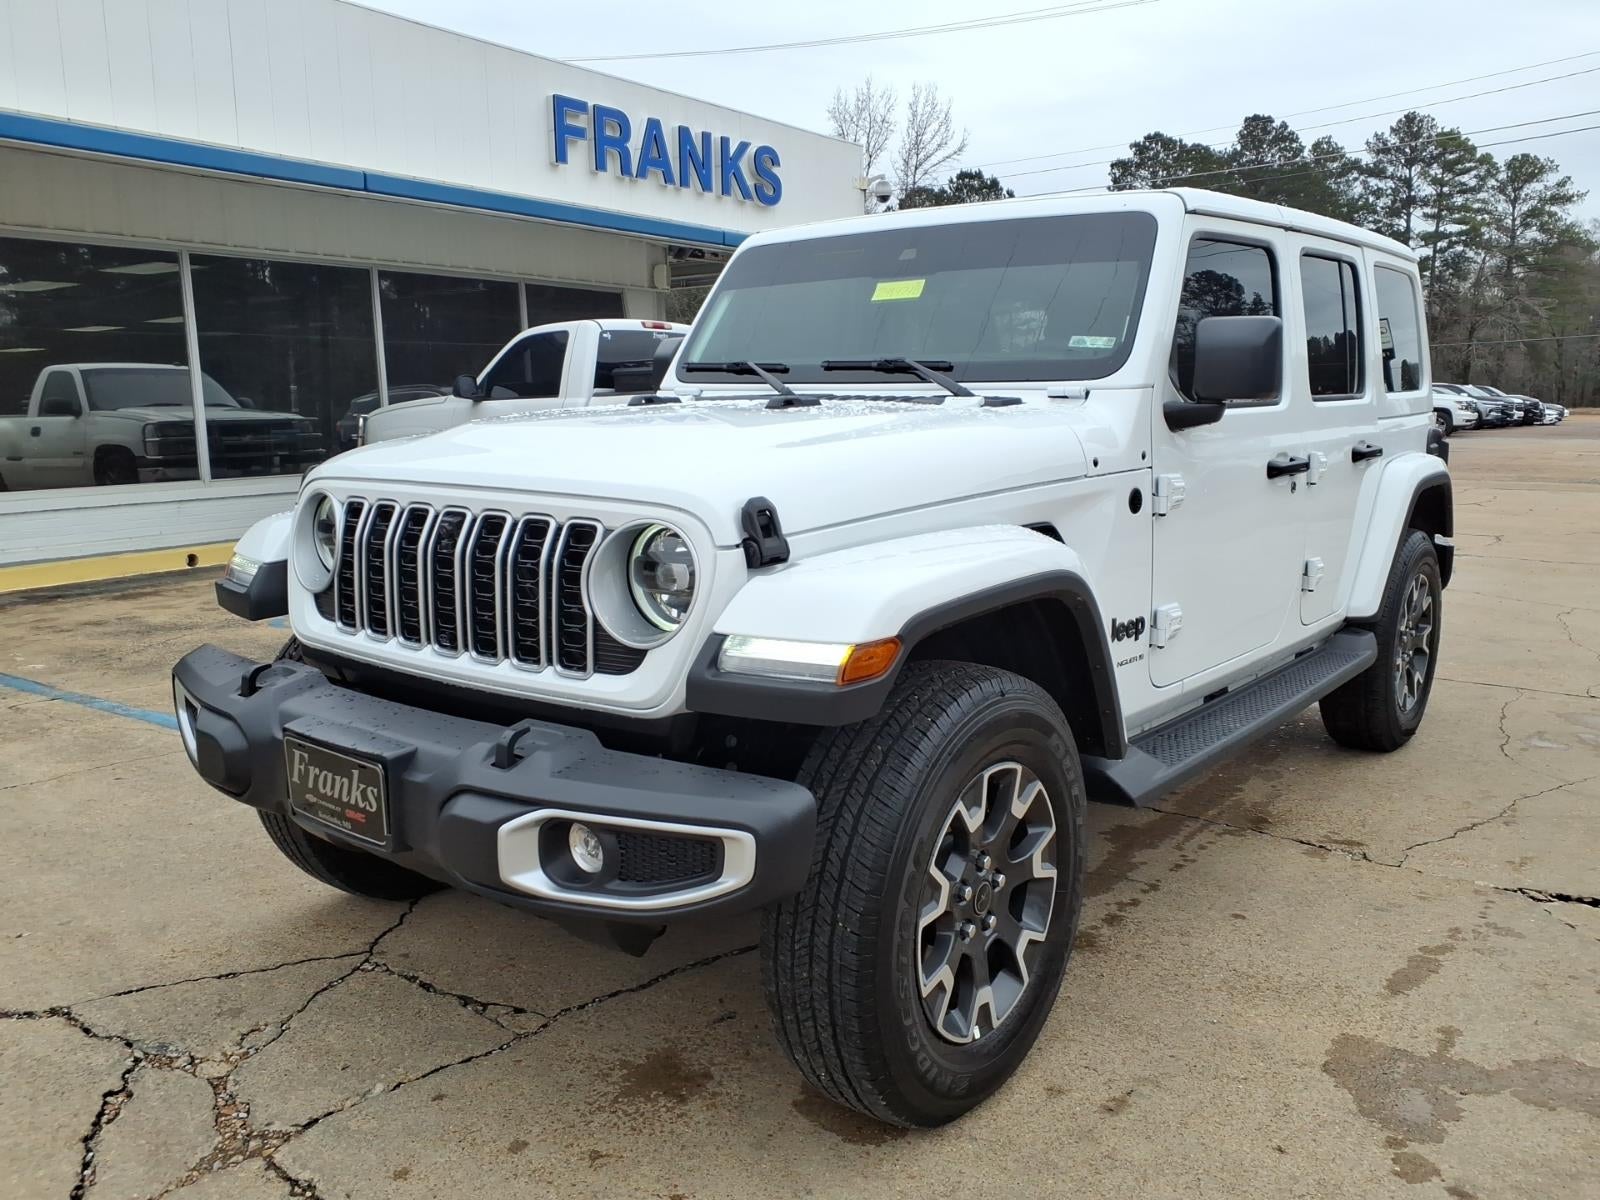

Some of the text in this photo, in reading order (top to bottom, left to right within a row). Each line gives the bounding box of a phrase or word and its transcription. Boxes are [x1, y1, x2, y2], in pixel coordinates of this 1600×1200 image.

[550, 93, 783, 207] FRANKS
[1111, 616, 1145, 643] Jeep
[291, 748, 378, 833] Franks
